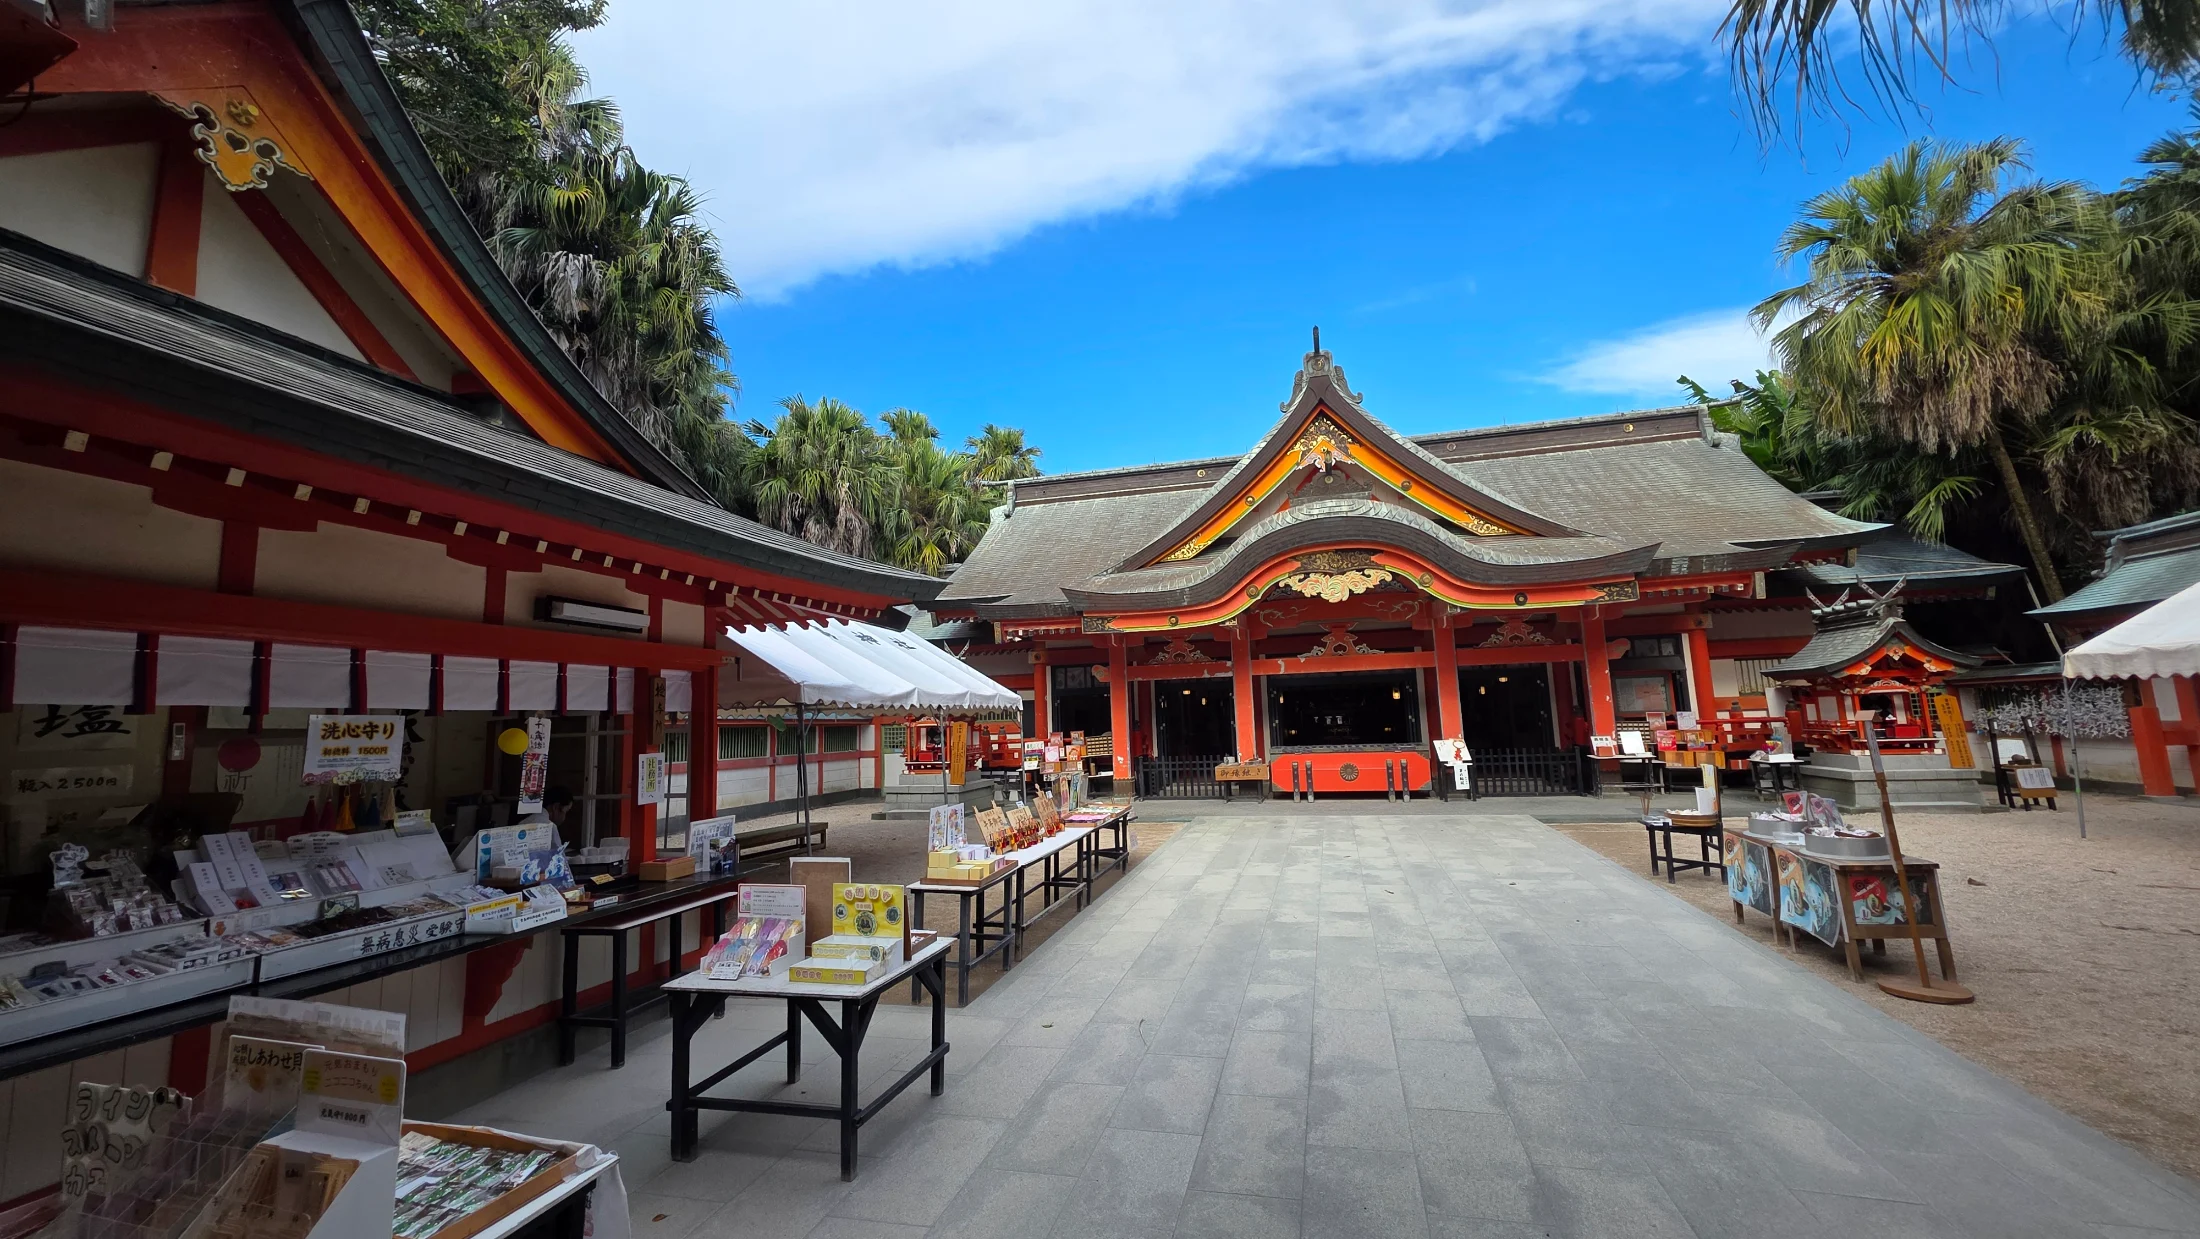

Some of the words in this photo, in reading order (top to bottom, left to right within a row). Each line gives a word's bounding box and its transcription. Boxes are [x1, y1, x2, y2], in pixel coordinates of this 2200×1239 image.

[320, 721, 395, 741] 洗心守り
[357, 745, 389, 756] 1500円
[361, 924, 419, 955] 無病息災
[247, 1047, 303, 1072] しあわせ貝
